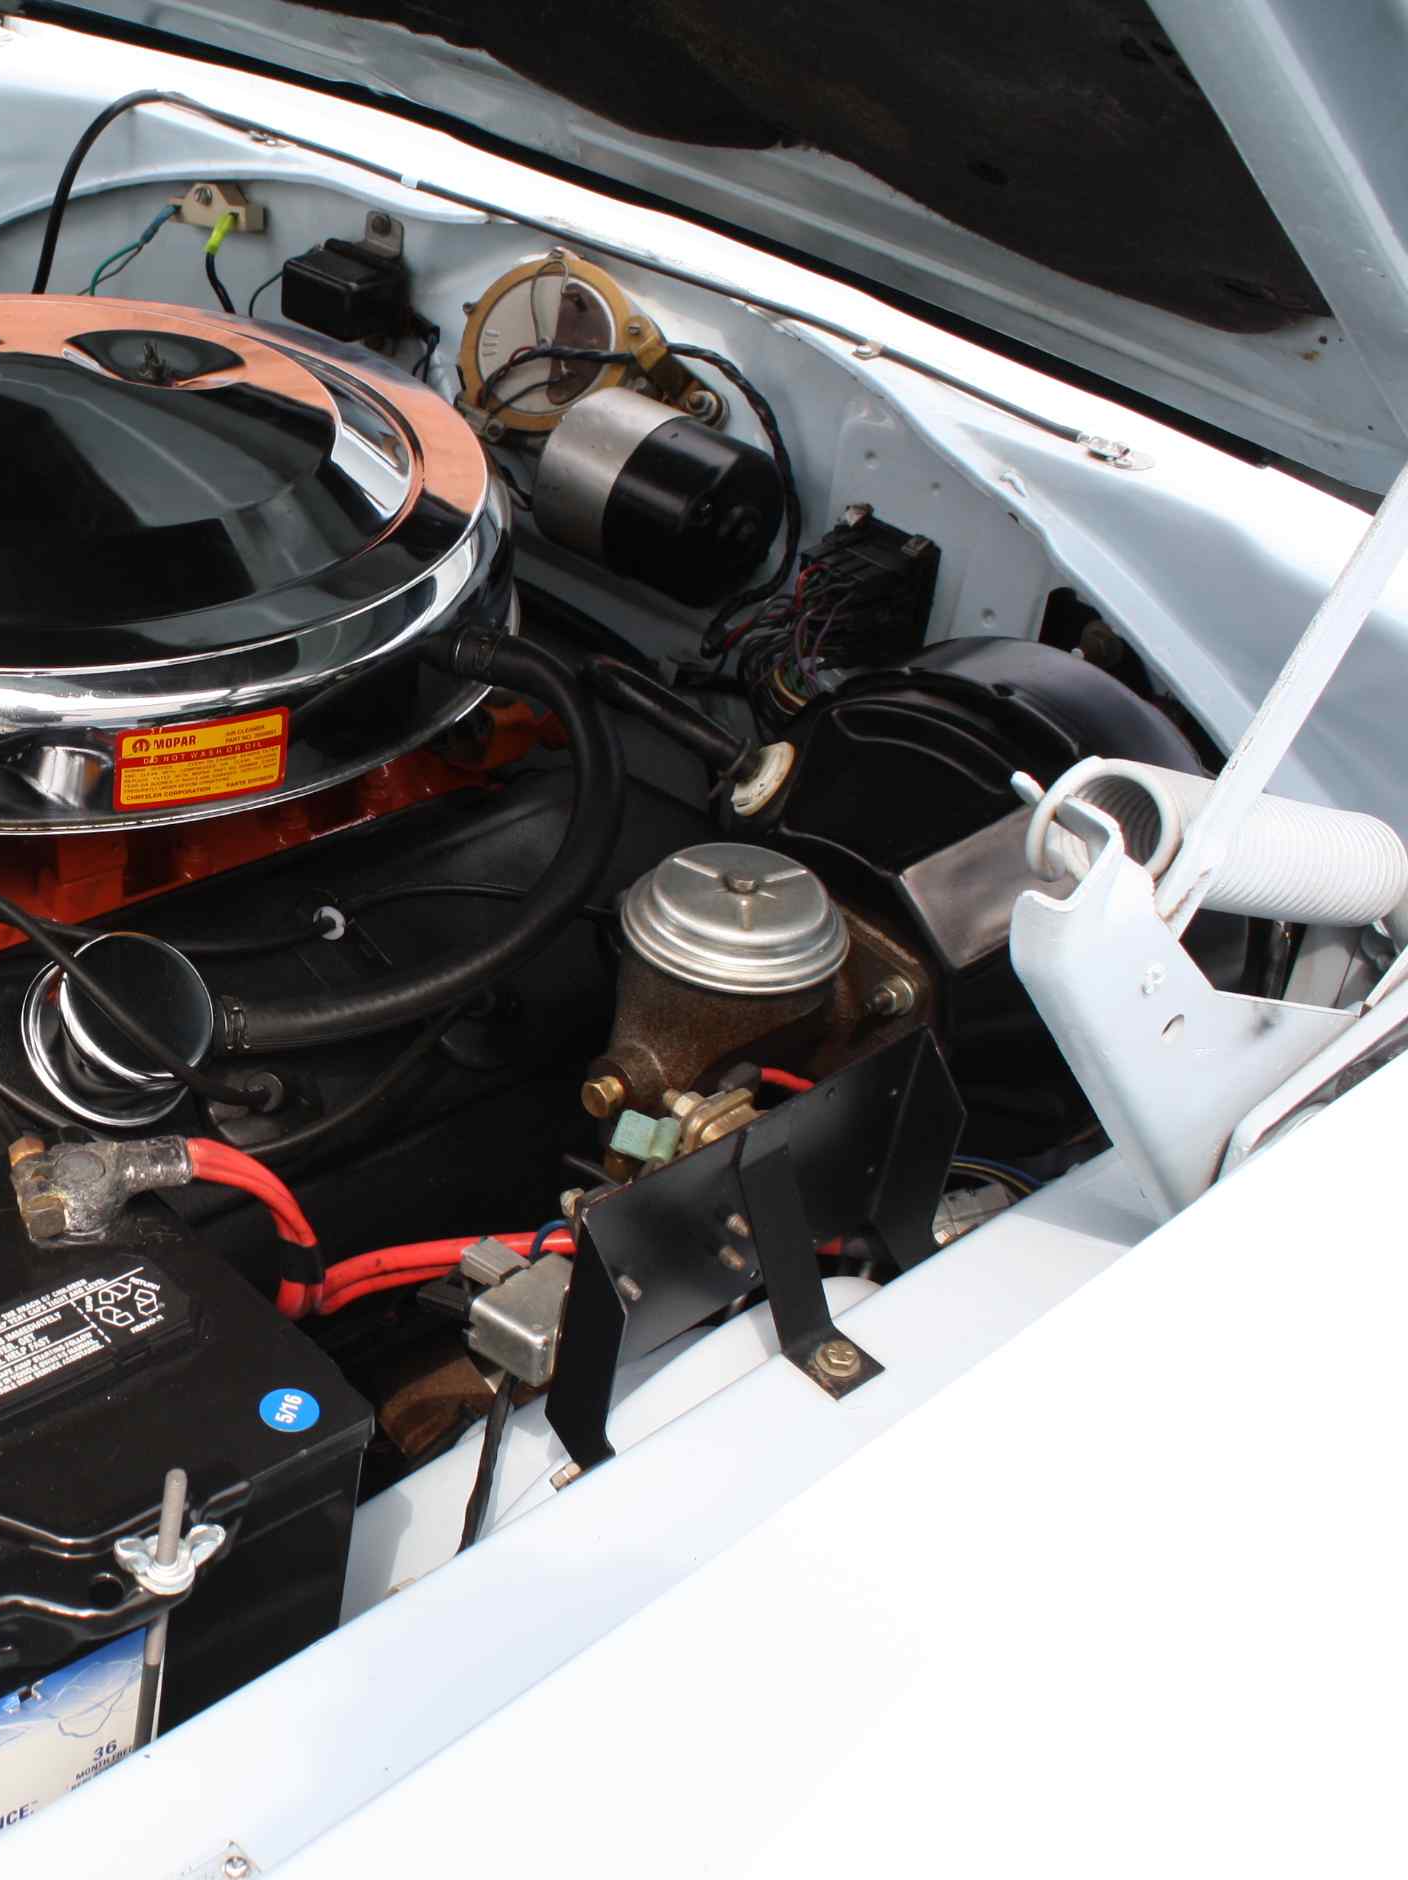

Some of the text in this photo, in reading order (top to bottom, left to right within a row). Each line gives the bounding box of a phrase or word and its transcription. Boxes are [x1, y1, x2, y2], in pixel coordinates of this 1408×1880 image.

[153, 733, 196, 751] MOPAR
[162, 752, 185, 763] NOT
[191, 747, 221, 758] WASH
[244, 740, 263, 750] OIL
[126, 790, 162, 803] CHRYSLER
[165, 783, 211, 798] CORPORATION
[1, 1309, 16, 1320] THE
[15, 1298, 41, 1313] REACH
[40, 1294, 51, 1302] OF
[7, 1312, 28, 1324] VENT
[26, 1303, 46, 1316] CAPS
[46, 1294, 68, 1307] TIGHT
[68, 1287, 84, 1297] AND
[4, 1311, 62, 1341] IMMEDIATELY
[4, 1346, 28, 1361] HELP
[28, 1336, 51, 1351] FAST
[17, 1333, 36, 1346] GET
[31, 1344, 65, 1363] STARTING
[64, 1332, 93, 1348] FOLLOW
[275, 1393, 303, 1423] 5/16
[93, 1739, 118, 1761] 36
